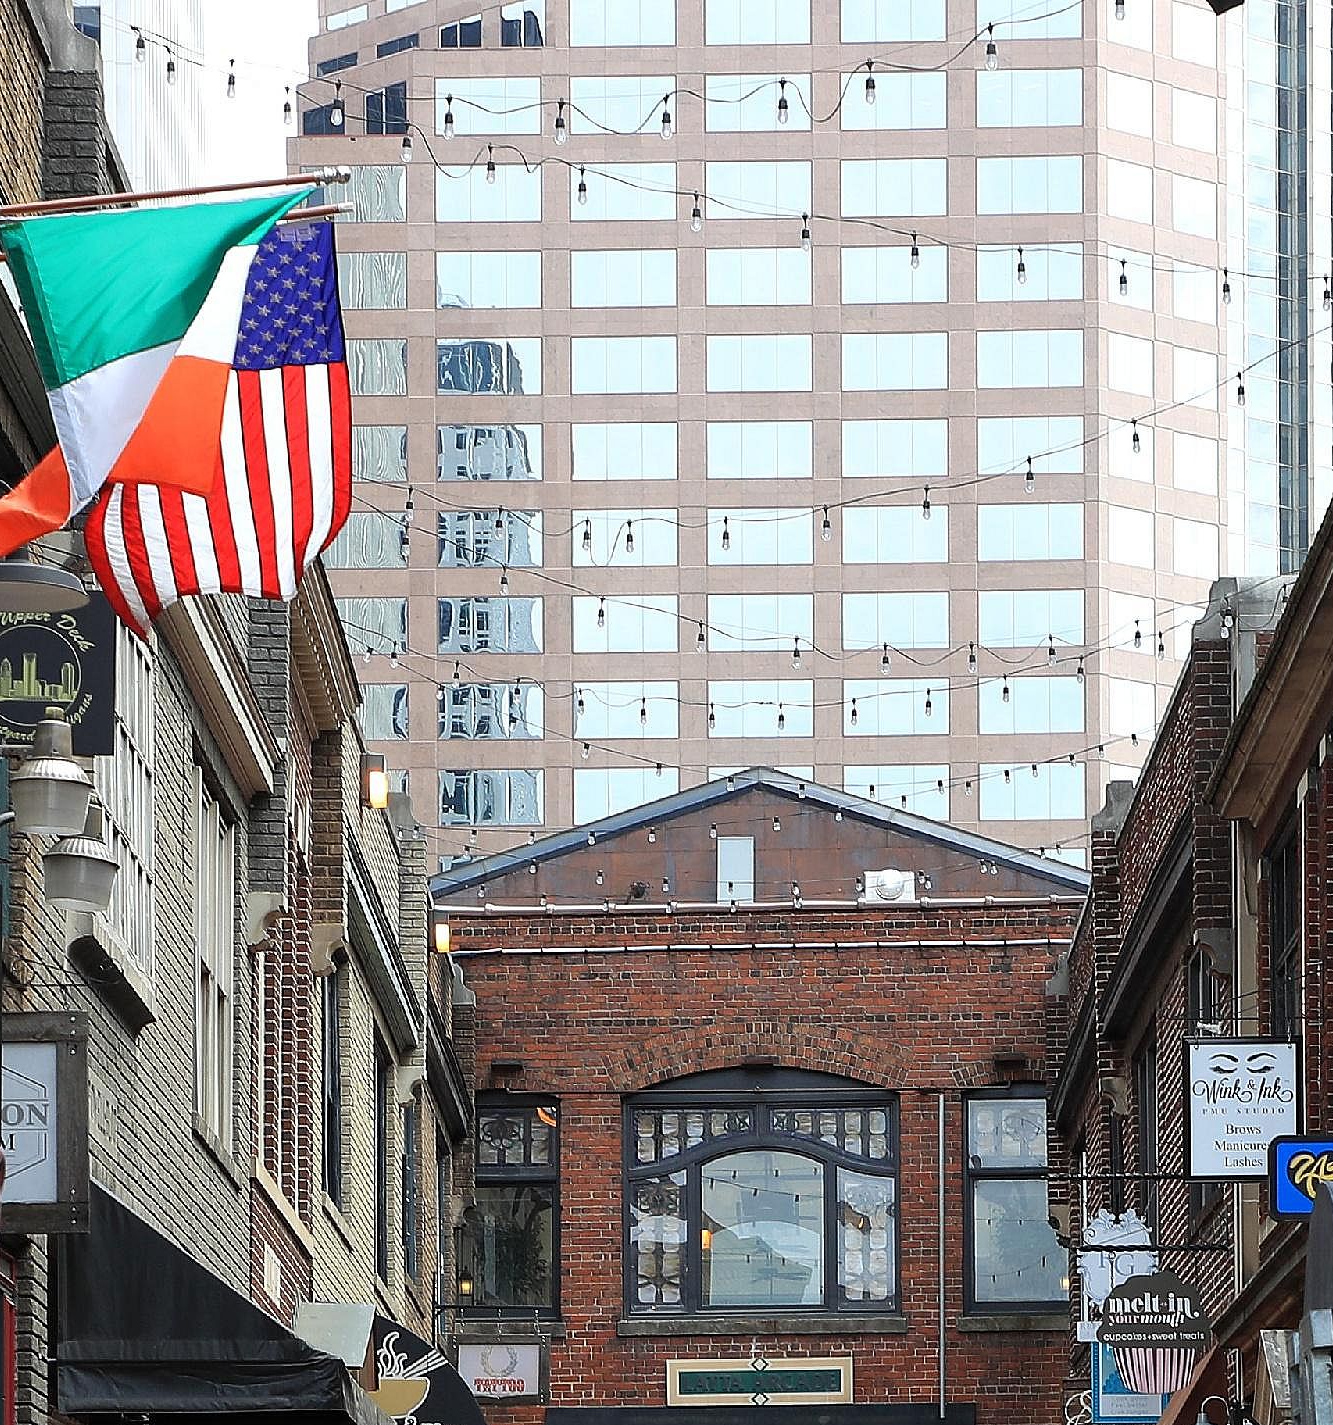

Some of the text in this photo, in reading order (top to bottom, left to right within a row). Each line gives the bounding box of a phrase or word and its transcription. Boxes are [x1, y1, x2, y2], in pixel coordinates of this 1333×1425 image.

[1192, 1077, 1252, 1104] Wink
[1257, 1077, 1294, 1104] Ink
[1226, 1124, 1262, 1135] Brows
[1214, 1141, 1268, 1151] Manicure
[1225, 1156, 1263, 1167] Lashes
